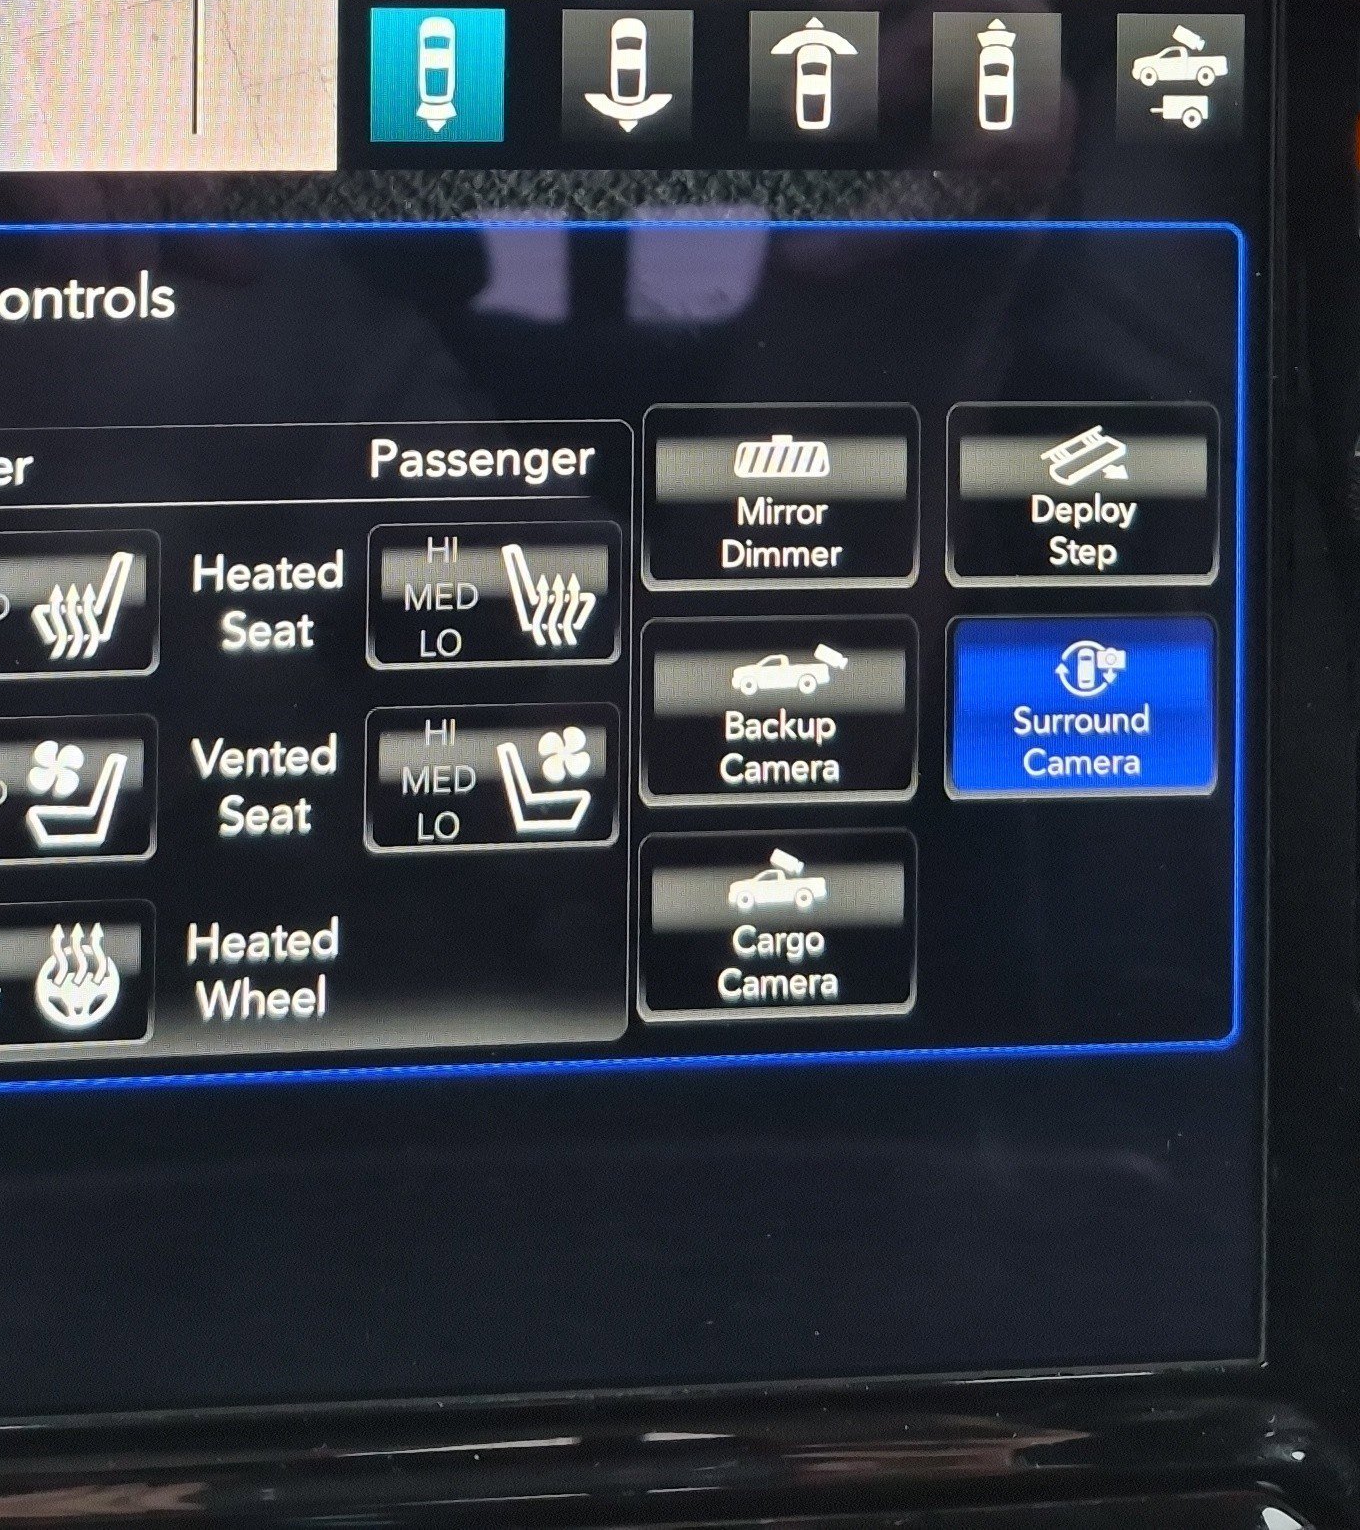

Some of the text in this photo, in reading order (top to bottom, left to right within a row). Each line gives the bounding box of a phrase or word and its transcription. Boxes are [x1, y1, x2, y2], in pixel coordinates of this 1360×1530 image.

[370, 438, 596, 485] Passenger
[737, 496, 829, 526] Mirror
[1031, 492, 1138, 530] Deploy
[427, 536, 459, 565] HI
[721, 538, 843, 569] Dimmer
[1049, 535, 1118, 571] Step
[192, 549, 344, 592] Heated
[403, 581, 480, 612] MED
[220, 610, 315, 651] Seat
[420, 628, 462, 658] LO
[424, 718, 457, 747] HI
[725, 709, 837, 746] Backup
[1013, 702, 1150, 736] Surround
[191, 732, 338, 780] Vented
[719, 752, 840, 785] Camera
[1023, 747, 1141, 777] Camera
[401, 766, 477, 796] MED
[218, 794, 312, 837] Seat
[417, 810, 460, 842] LO
[187, 915, 339, 962] Heated
[732, 924, 825, 961] Cargo
[195, 973, 327, 1023] Wheel
[717, 967, 839, 1000] Camera
